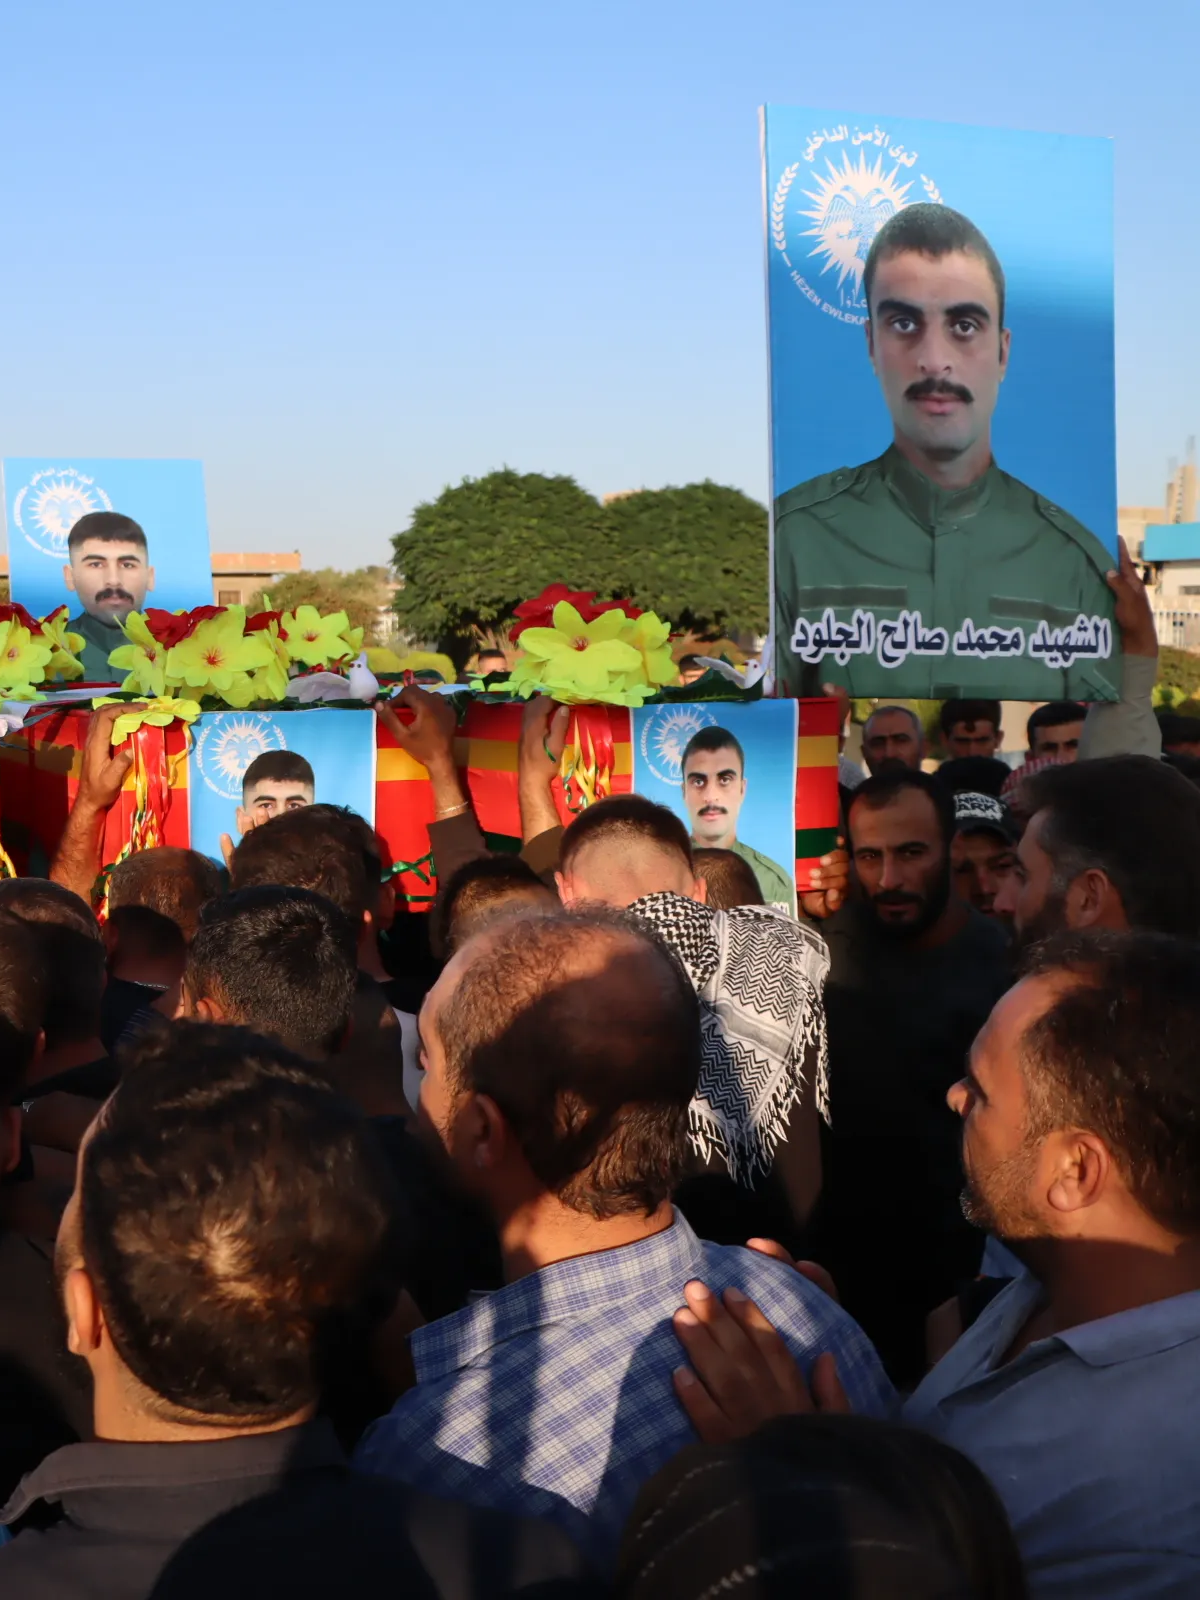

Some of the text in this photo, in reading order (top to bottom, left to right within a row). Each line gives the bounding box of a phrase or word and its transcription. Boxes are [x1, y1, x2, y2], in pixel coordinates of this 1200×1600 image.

[851, 124, 890, 148] الأمن
[791, 609, 1112, 668] الشهيد محمد صالح الجلود
[956, 802, 997, 814] ARK
